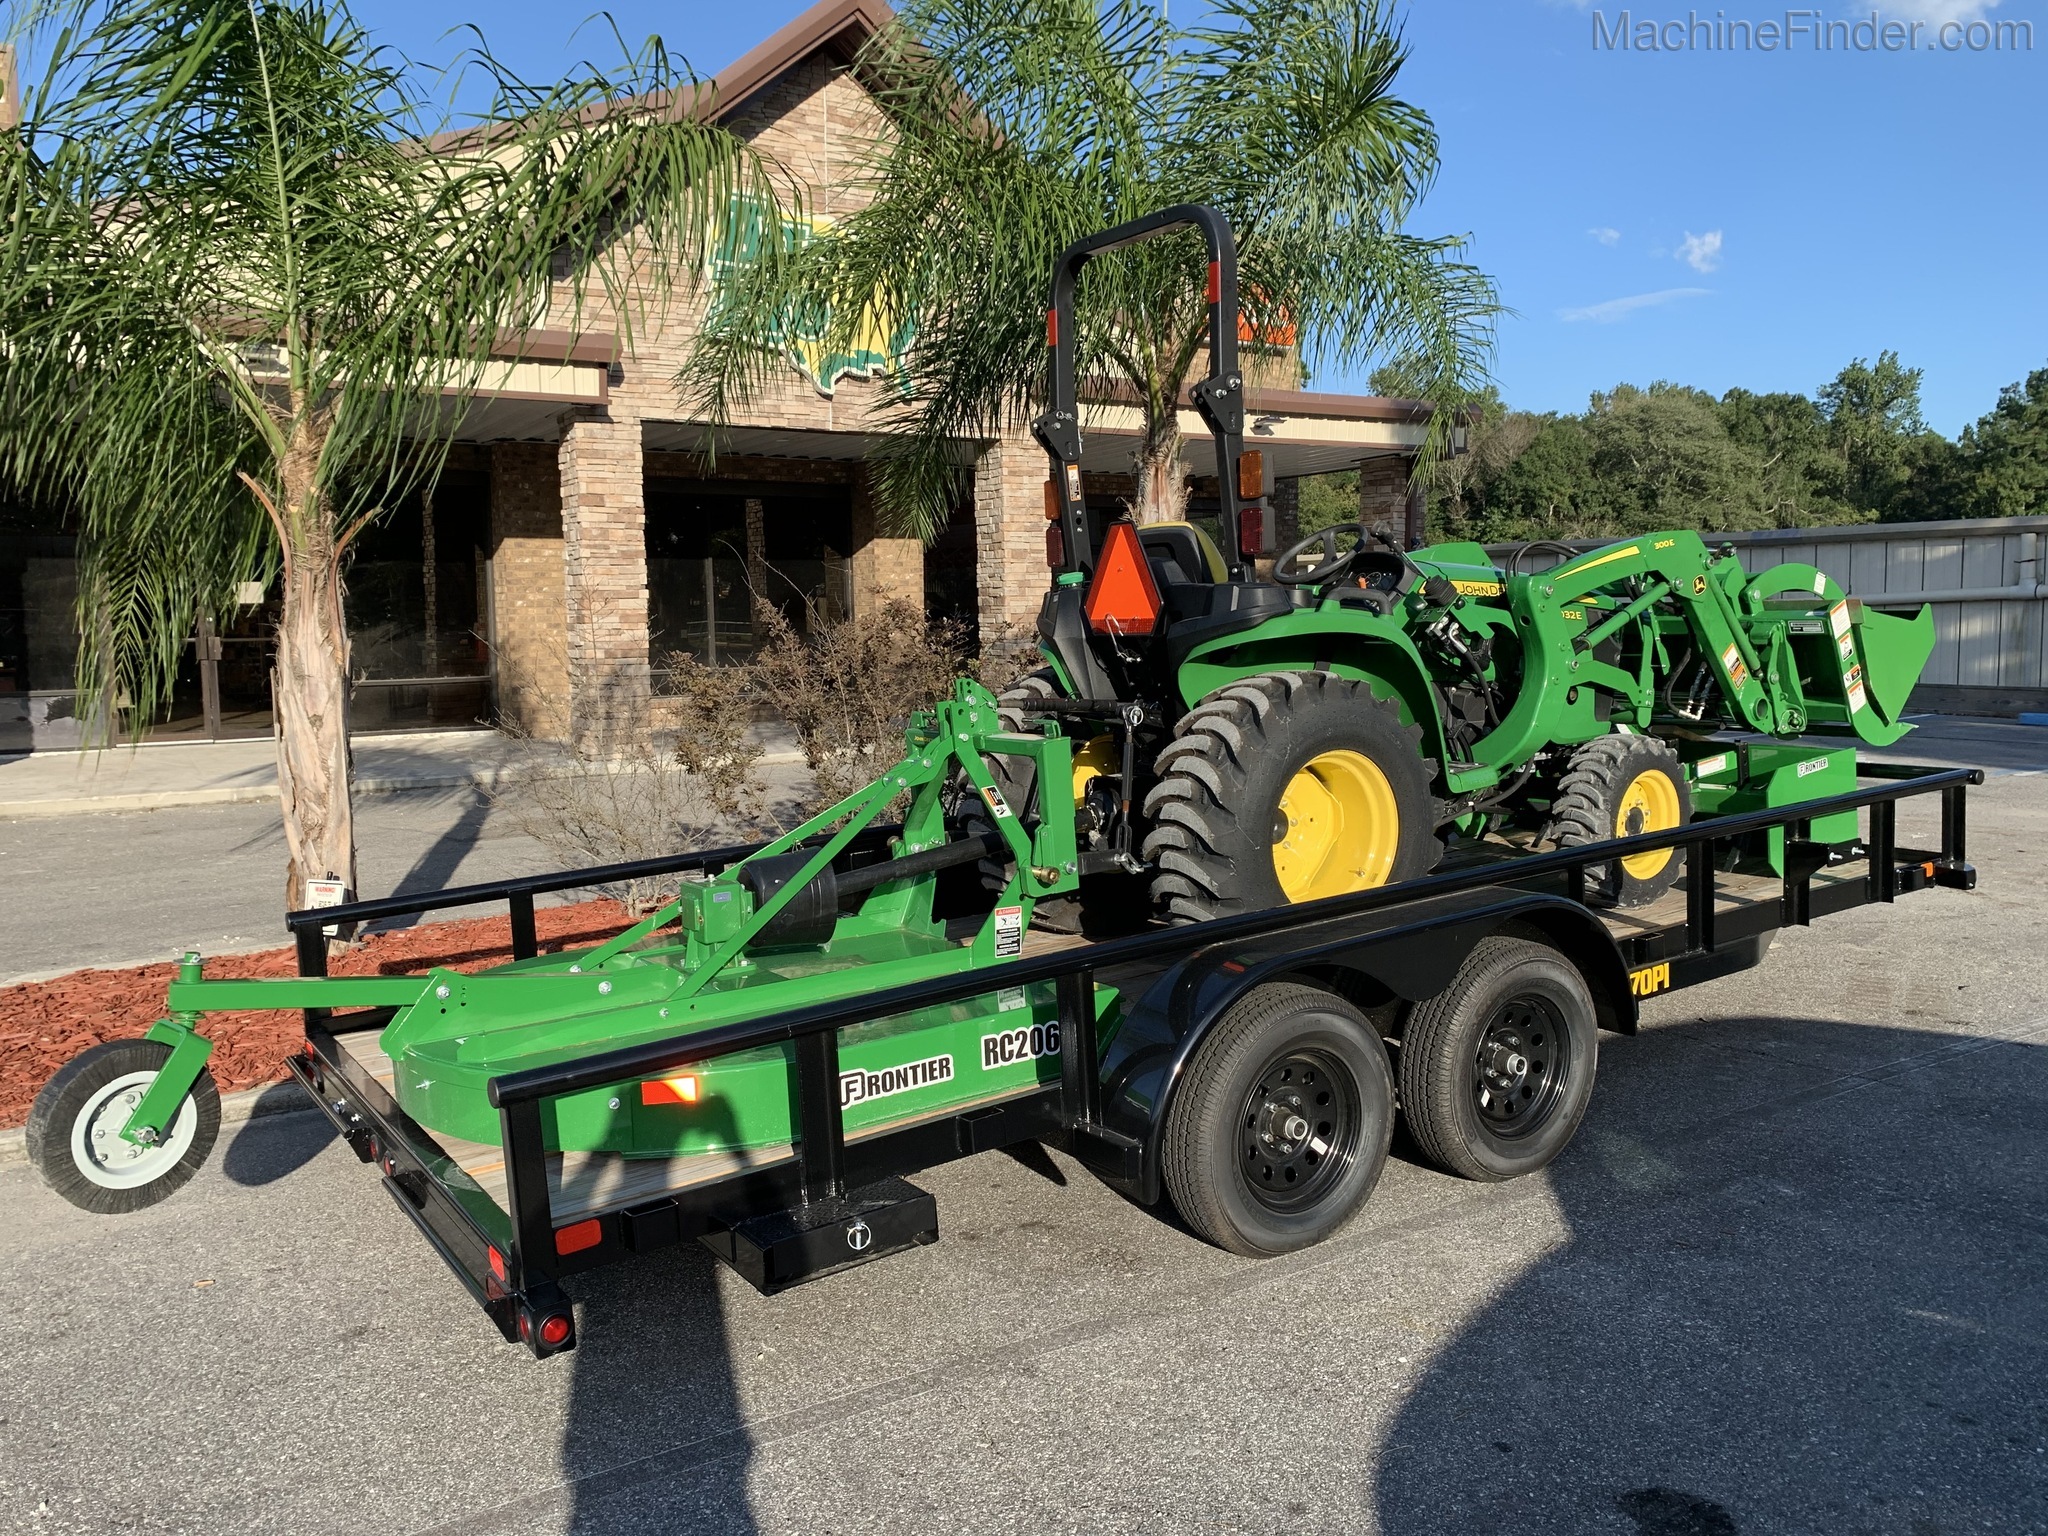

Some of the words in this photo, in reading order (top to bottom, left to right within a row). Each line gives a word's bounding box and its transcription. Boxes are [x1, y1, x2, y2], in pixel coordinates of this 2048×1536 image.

[1653, 539, 1675, 550] 300E
[1460, 584, 1488, 595] JOHN
[1798, 758, 1827, 777] FRONTIER
[838, 1056, 952, 1107] FRONTIER
